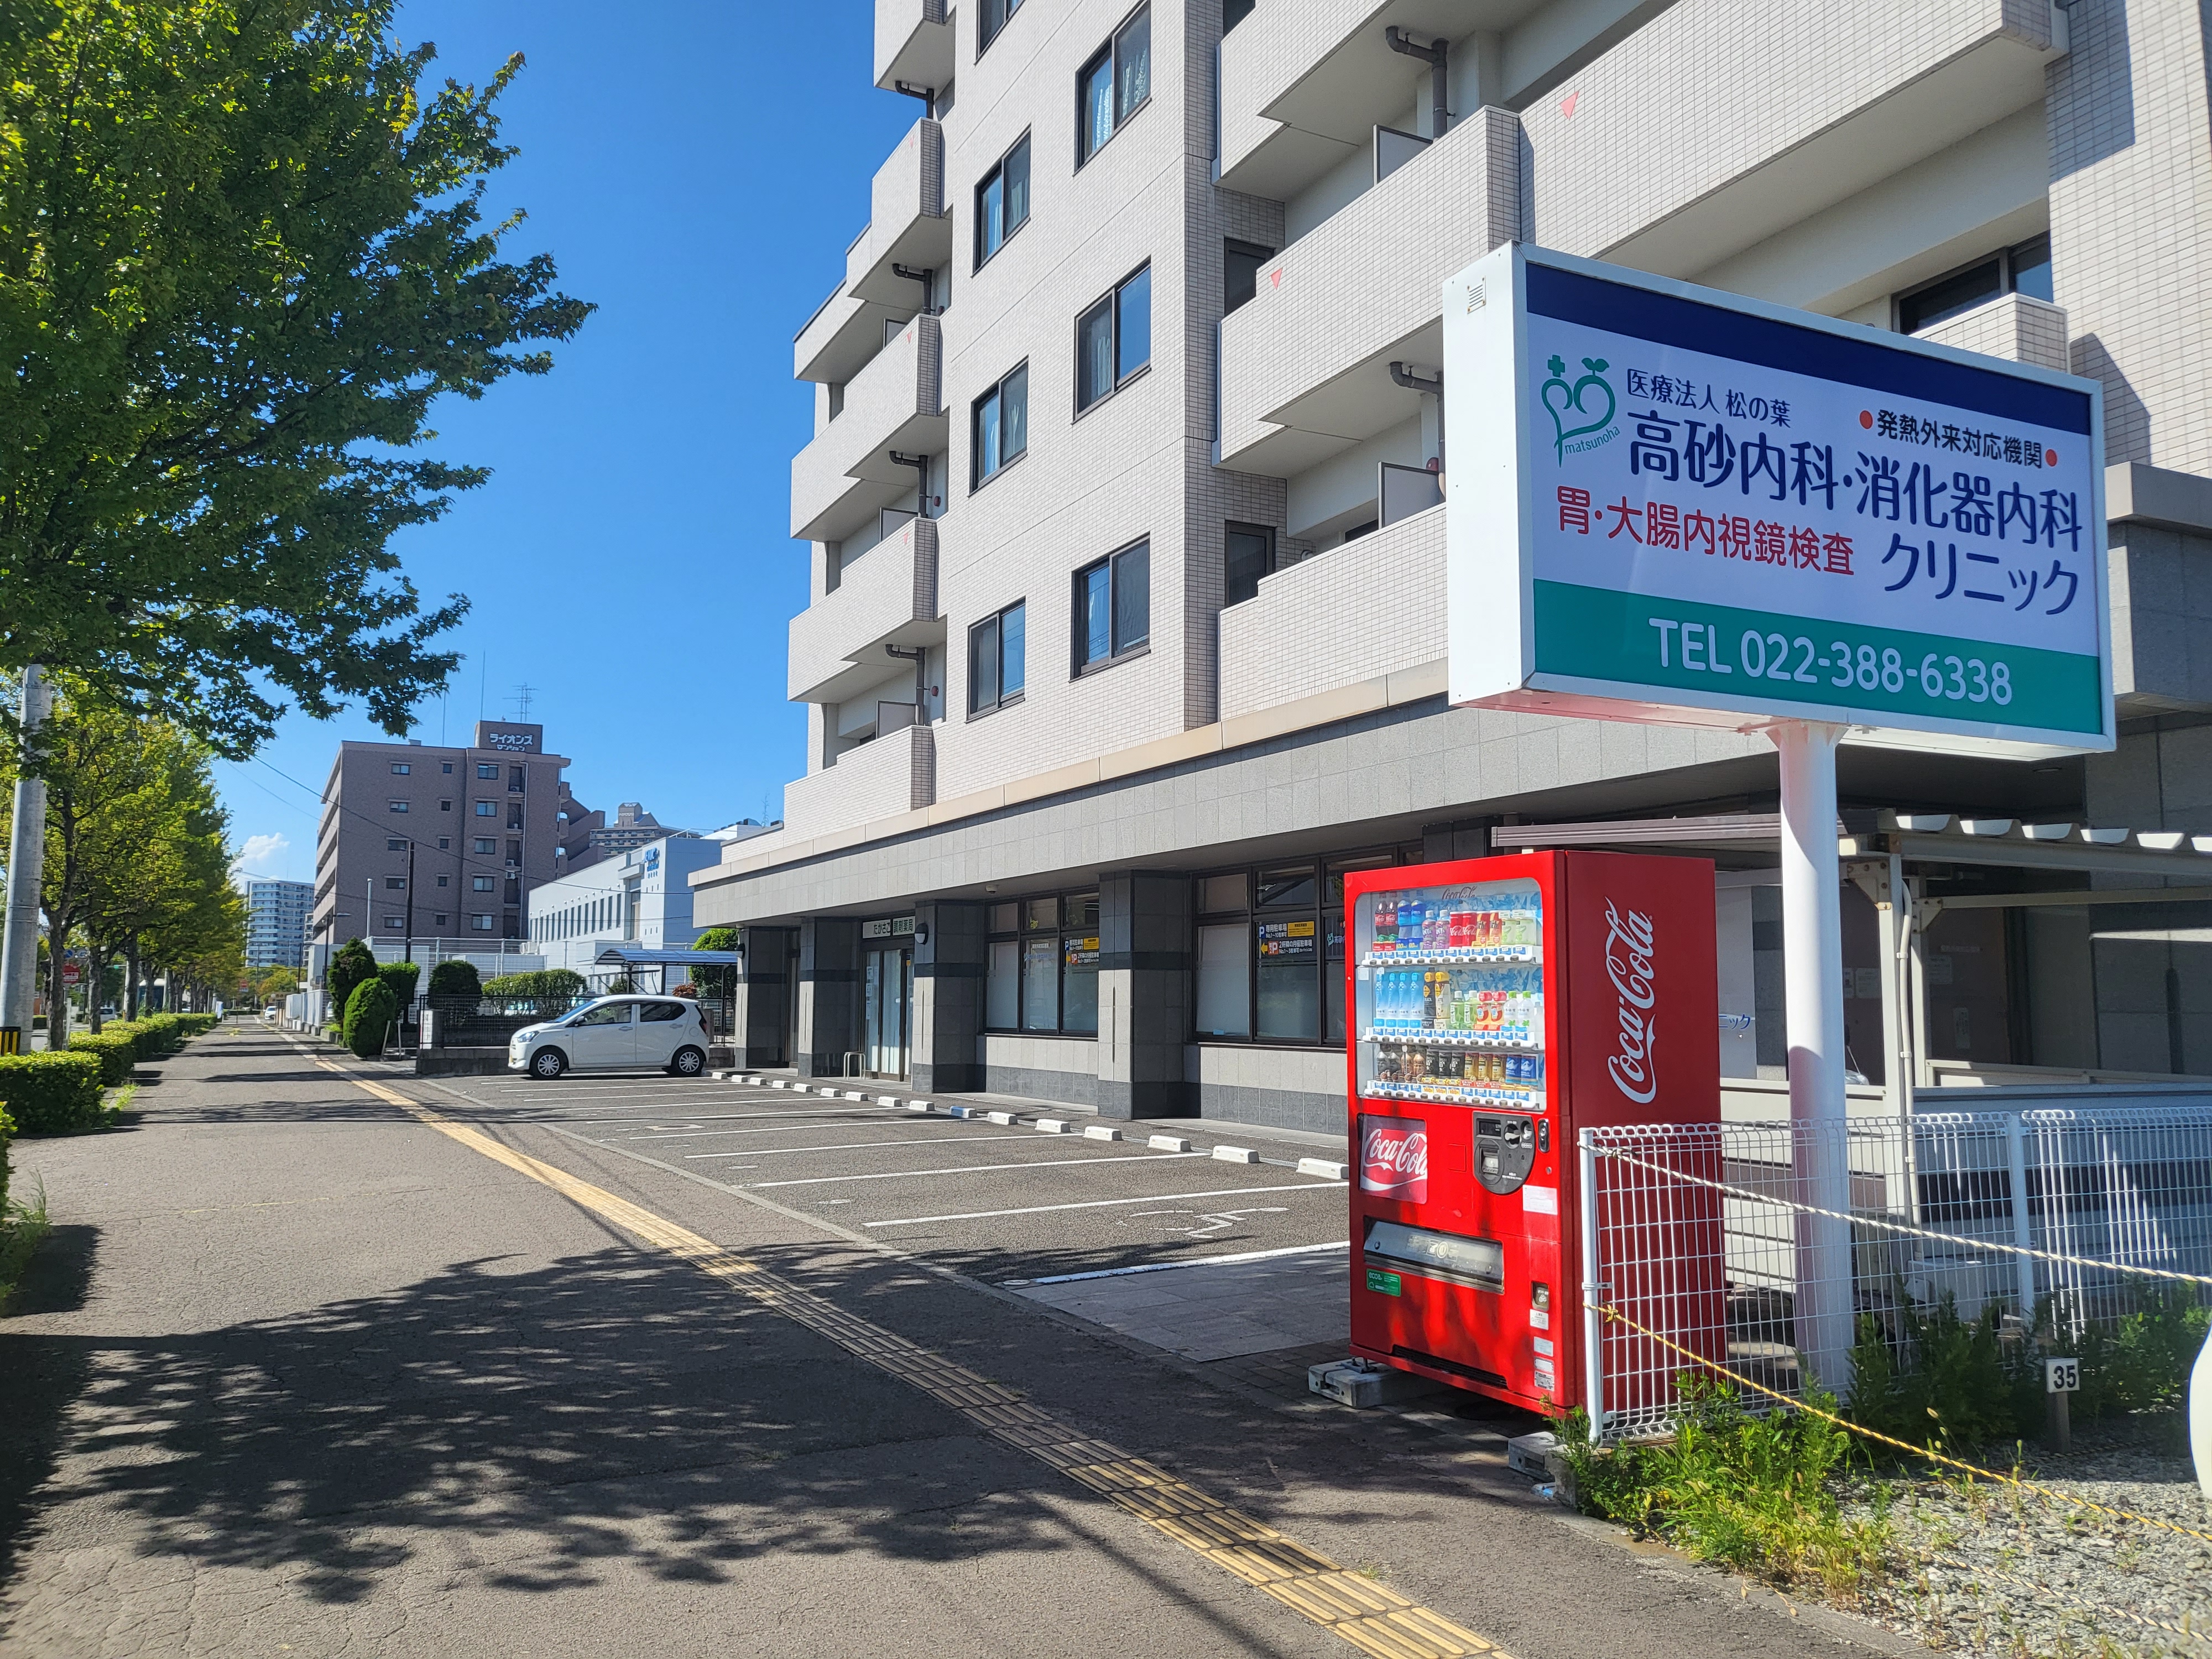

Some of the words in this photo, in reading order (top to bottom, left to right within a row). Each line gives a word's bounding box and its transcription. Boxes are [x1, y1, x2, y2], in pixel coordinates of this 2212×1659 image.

[1627, 368, 1720, 414] 医療法人
[1725, 389, 1791, 428] 松の葉
[1564, 425, 1620, 455] matsunoha
[1877, 409, 2042, 469] 発熱外来対応機関
[1557, 486, 1854, 575] 胃・大腸内視鏡検査
[1881, 533, 2078, 615] クリニック
[1648, 618, 1733, 674] TEL
[1740, 630, 2013, 706] 022-388-6338
[489, 733, 533, 745] ライオンズ
[1259, 926, 1265, 938] P
[1605, 896, 1656, 1104] Coca-Cola
[2053, 1365, 2077, 1389] 35
